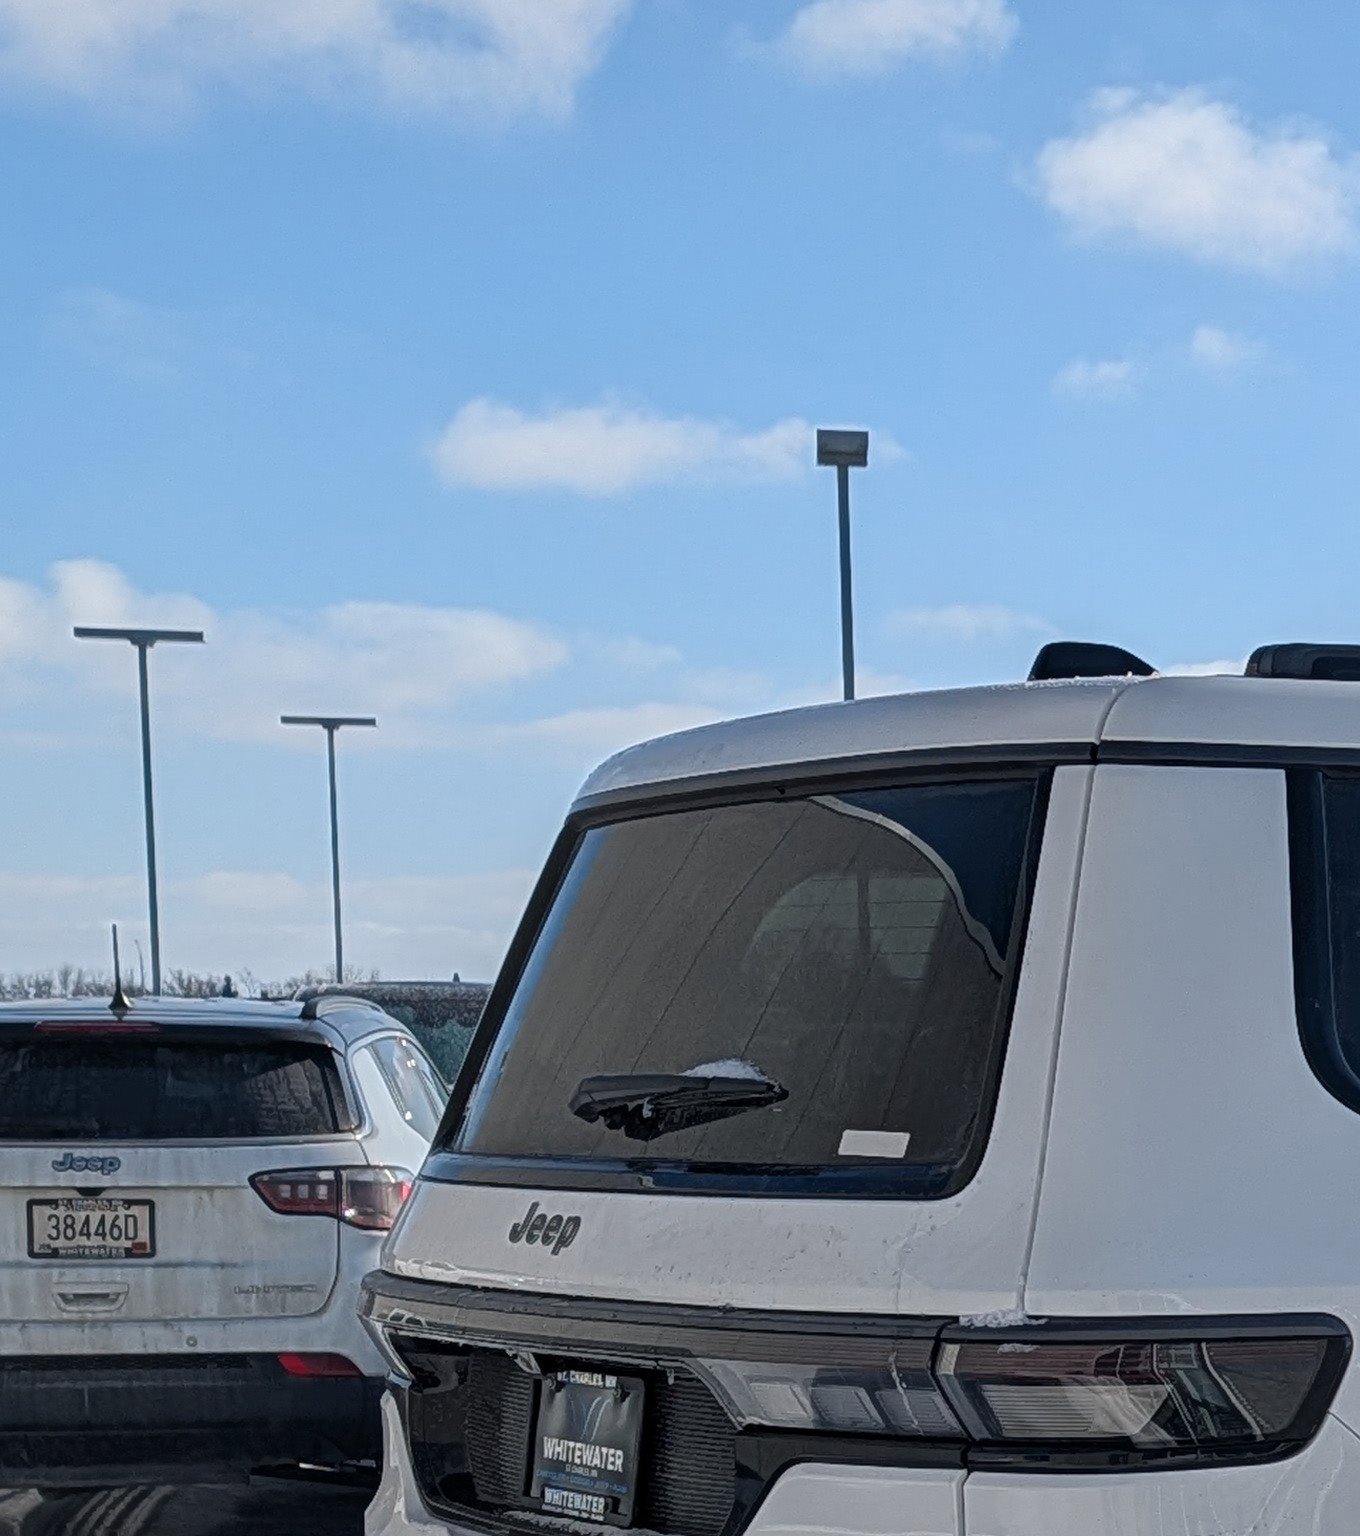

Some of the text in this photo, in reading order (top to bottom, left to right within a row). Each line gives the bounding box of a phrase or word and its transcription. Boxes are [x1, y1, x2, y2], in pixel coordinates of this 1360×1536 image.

[51, 1153, 122, 1176] Jeep
[47, 1214, 139, 1241] 38446D
[508, 1201, 582, 1256] Jeep
[543, 1436, 624, 1473] WHITEWATER
